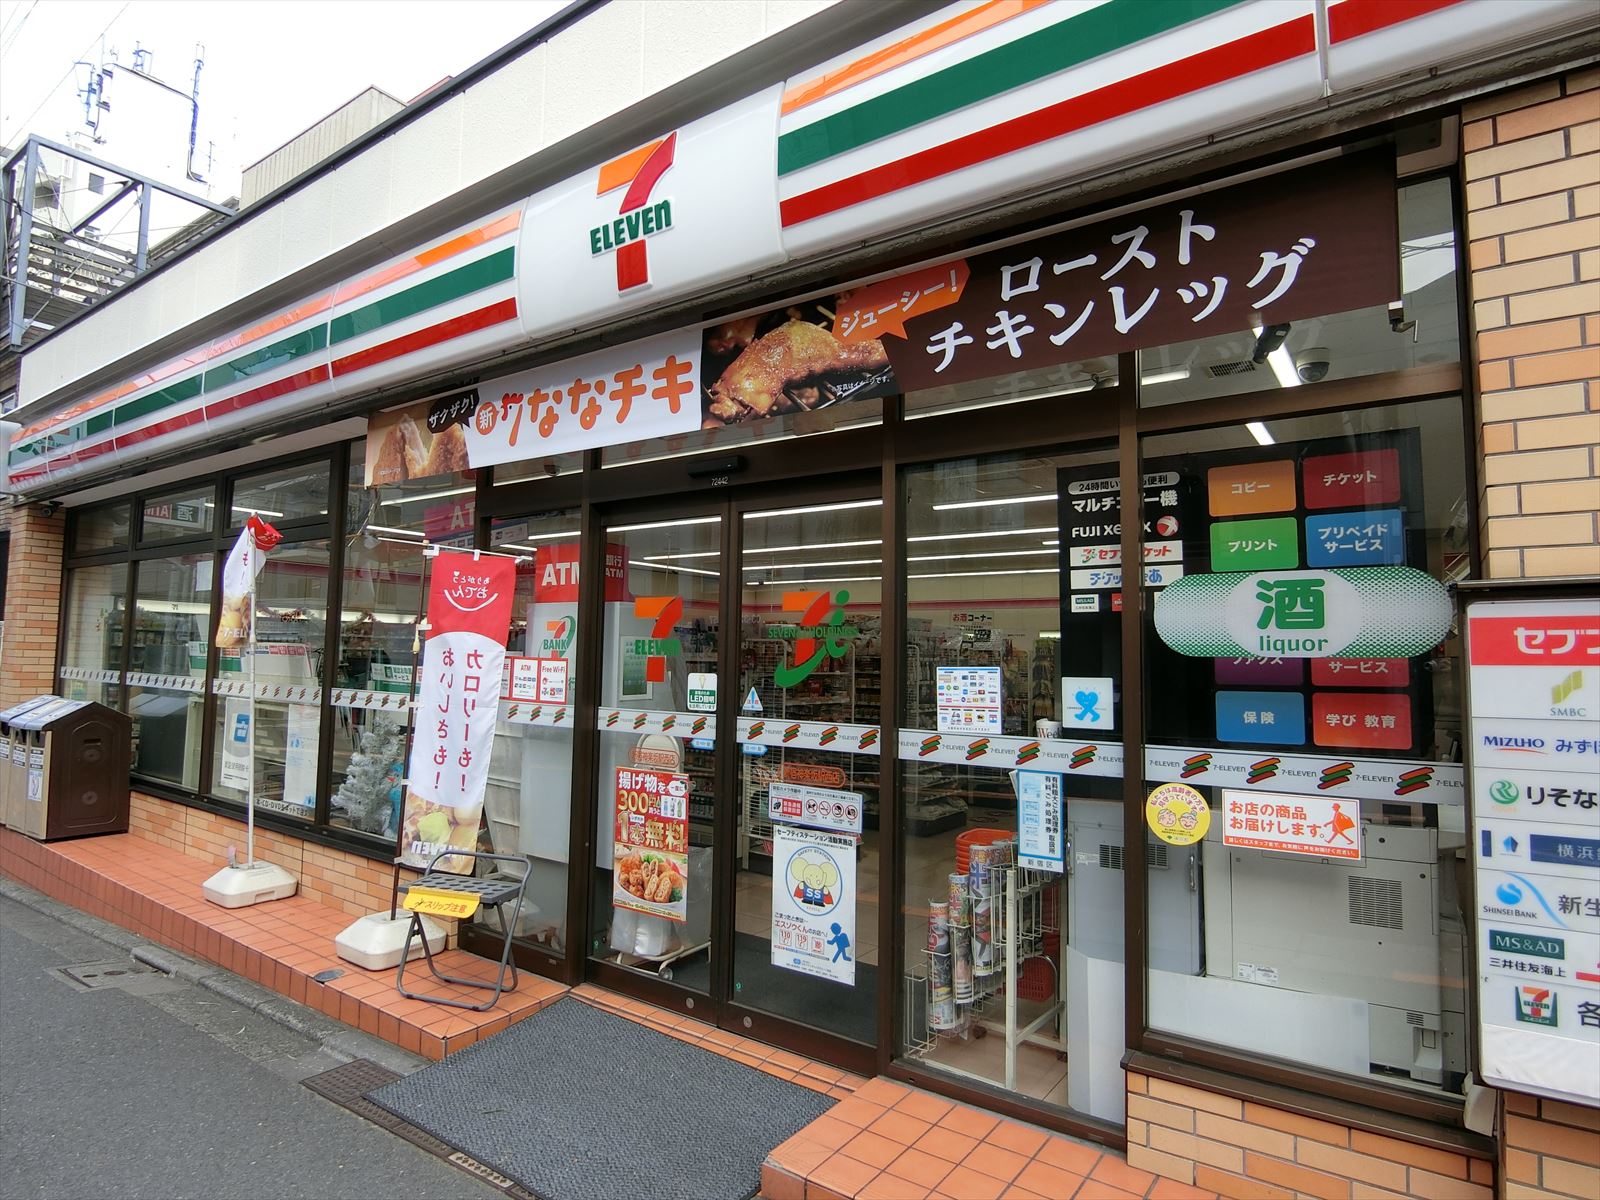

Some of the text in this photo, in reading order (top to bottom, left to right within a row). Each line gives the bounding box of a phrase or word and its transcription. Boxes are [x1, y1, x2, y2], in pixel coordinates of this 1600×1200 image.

[1000, 209, 1216, 302] ロースト
[841, 269, 958, 337] ジューシー!
[925, 238, 1316, 373] チキンレッグ
[428, 395, 475, 427] ザクザク!
[479, 409, 493, 430] 新
[1322, 470, 1377, 486] チケット
[1231, 481, 1271, 494] コピー
[1072, 489, 1178, 513] マルチー機
[450, 502, 476, 530] AT
[1072, 526, 1100, 538] FUJI
[1318, 523, 1388, 538] プリペイド
[1228, 539, 1278, 553] プリント
[1324, 538, 1383, 553] サービス
[1256, 578, 1326, 630] 酒
[952, 613, 992, 622] お酒コーナー
[543, 639, 568, 650] BANK
[1259, 635, 1328, 656] liquor
[1328, 661, 1389, 674] サービス
[1243, 711, 1275, 725] 保険
[1550, 707, 1587, 717] SMBC
[1326, 713, 1396, 729] 学び 教育
[1483, 735, 1545, 748] MIZUHO
[619, 770, 666, 795] 揚げ物を
[1526, 786, 1598, 809] りそな
[1229, 800, 1307, 820] お店の商品
[1229, 816, 1324, 838] お届けします。
[806, 888, 821, 899] SS
[1483, 905, 1514, 916] SHINSEI
[1514, 908, 1537, 920] BANK
[1495, 935, 1560, 954] MS&AD
[1489, 957, 1567, 978] 三井住友海上
